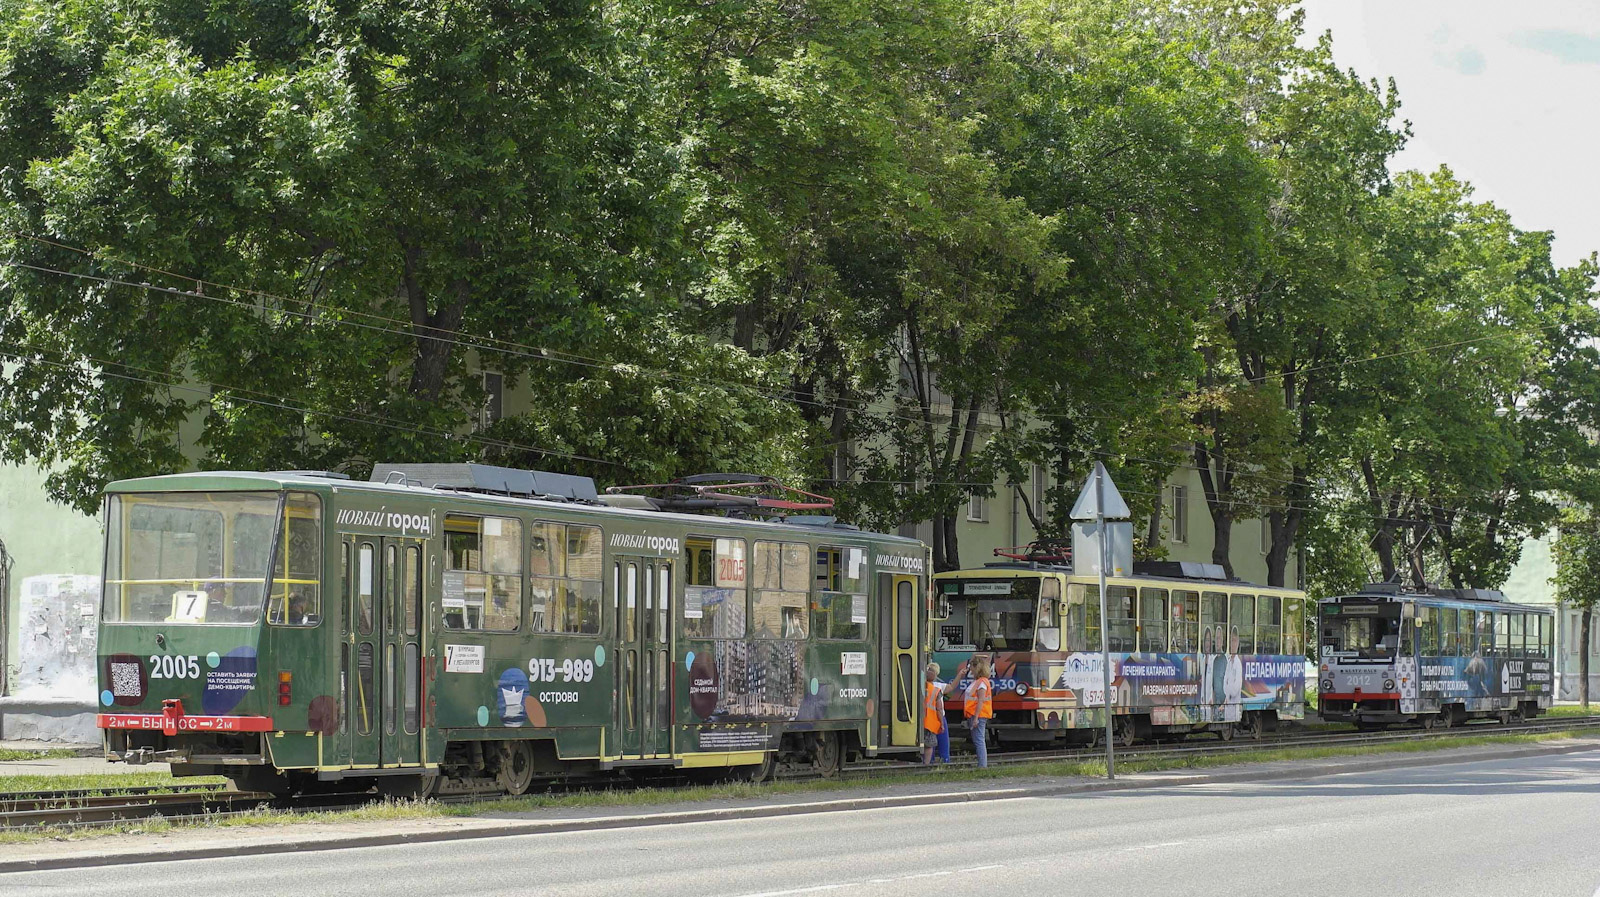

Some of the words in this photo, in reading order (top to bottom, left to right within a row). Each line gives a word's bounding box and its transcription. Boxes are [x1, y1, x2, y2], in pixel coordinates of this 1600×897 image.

[387, 512, 430, 535] город
[647, 536, 680, 555] город
[720, 558, 745, 581] 2005
[901, 556, 923, 573] город
[186, 594, 198, 616] 7
[938, 638, 946, 650] 2
[1325, 646, 1331, 655] 2
[448, 646, 454, 665] 7
[150, 654, 200, 679] 2005
[528, 658, 594, 682] 913-989
[1122, 665, 1145, 676] ЛЕЧЕНИЕ
[1146, 666, 1176, 676] КАТАРАКТЫ
[1244, 662, 1276, 680] ДЕЛАЕМ
[1277, 662, 1292, 678] МИР
[1346, 675, 1371, 686] 2012
[540, 692, 579, 704] острова
[839, 688, 868, 698] острова
[1142, 685, 1168, 695] ЛАЗЕРНАЯ
[1170, 684, 1198, 695] КОРРЕКЦИЯ
[142, 718, 197, 730] ВЫНОС
